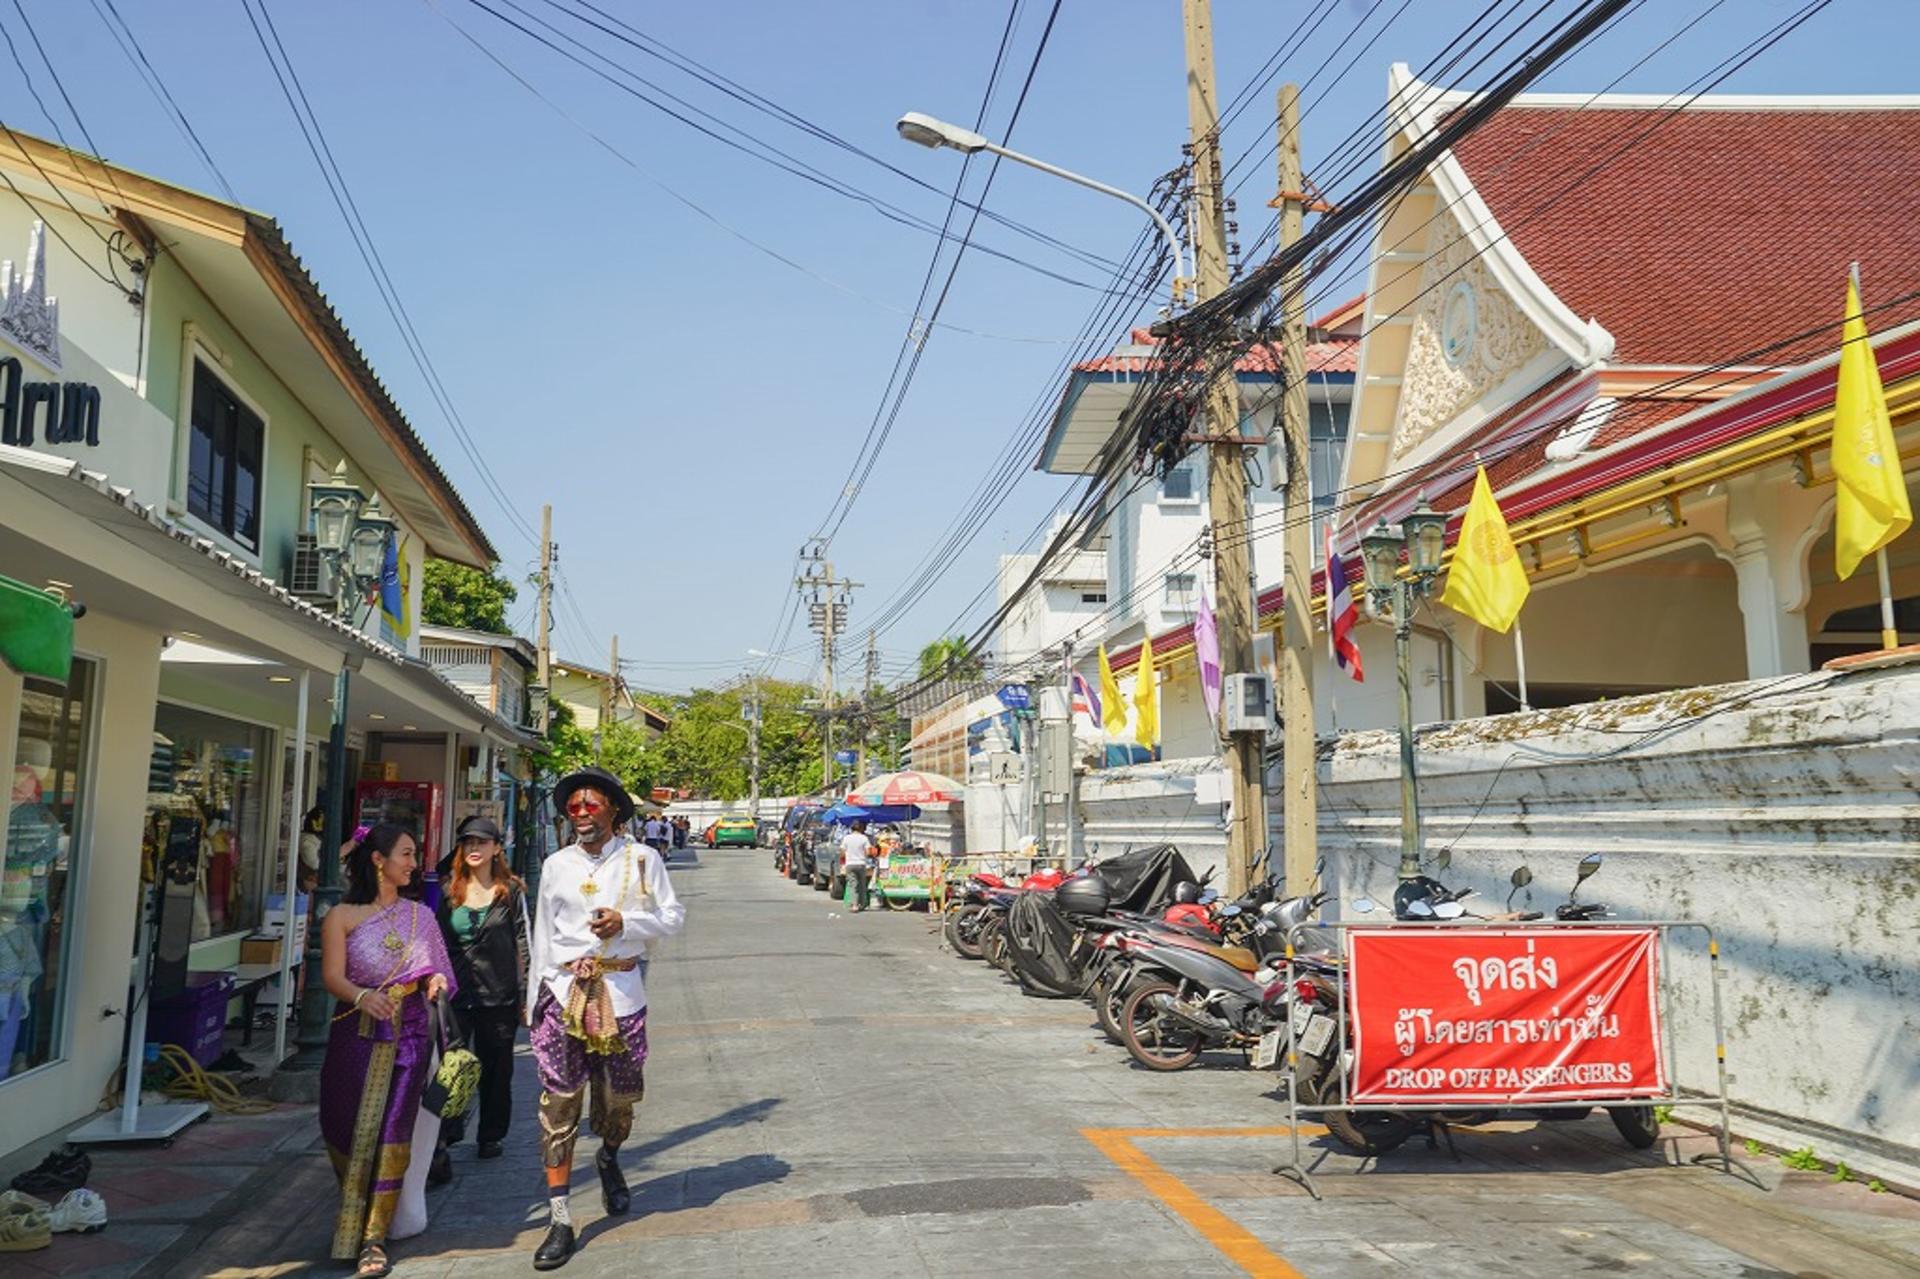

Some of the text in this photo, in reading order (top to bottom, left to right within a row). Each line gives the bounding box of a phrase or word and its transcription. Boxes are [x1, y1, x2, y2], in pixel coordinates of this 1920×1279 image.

[1452, 938, 1559, 1007] จุดส่ง
[1393, 994, 1621, 1057] ผู้โดยสารเท่านั้น
[1384, 1062, 1633, 1089] DROP OFF PASSENGERS
